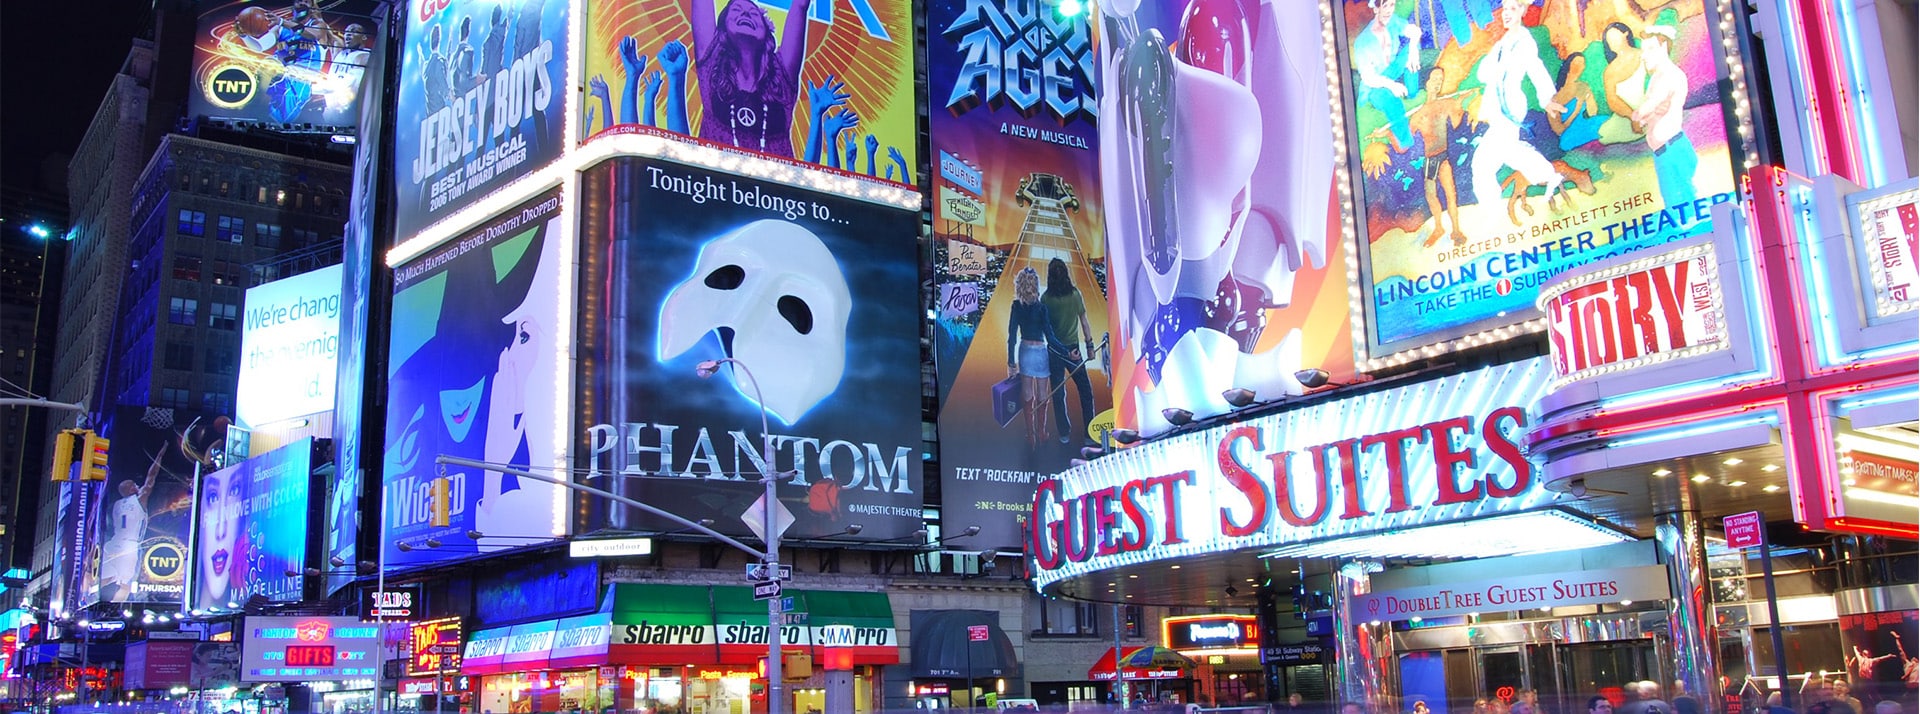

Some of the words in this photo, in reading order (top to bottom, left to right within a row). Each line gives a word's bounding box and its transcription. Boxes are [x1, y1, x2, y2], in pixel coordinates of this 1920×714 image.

[1025, 26, 1053, 51] OF
[216, 80, 250, 94] TNT
[412, 79, 491, 185] JERSEY
[493, 40, 553, 140] BOYS
[1000, 122, 1008, 134] A
[1011, 124, 1038, 140] NEW
[1041, 130, 1089, 150] MUSICAL
[430, 168, 464, 198] BEST
[466, 134, 527, 174] MUSICAL
[942, 158, 980, 188] JOURNEY
[429, 191, 448, 212] 2006
[448, 179, 467, 203] TONY
[466, 166, 496, 193] AWARD
[494, 148, 527, 176] WINNER
[647, 166, 727, 204] Tonight
[732, 181, 806, 221] belongs
[1438, 236, 1501, 262] DIRECTED
[1507, 230, 1527, 244] BY
[1531, 204, 1608, 238] BARTLETT
[1613, 192, 1654, 214] SHER
[405, 264, 424, 282] MUCH
[424, 248, 459, 272] HAPPENED
[459, 233, 484, 256] BEFORE
[486, 214, 522, 242] DOROTHY
[522, 200, 558, 224] DROPPED
[960, 244, 974, 259] Pat
[1880, 236, 1902, 269] STORY
[951, 258, 986, 274] Benatar
[1378, 262, 1478, 306] LINCOLN
[1486, 230, 1596, 278] CENTER
[1414, 297, 1457, 316] TAKE
[1460, 285, 1492, 300] THE
[1690, 281, 1712, 312] WEST
[246, 304, 287, 331] We're
[290, 294, 339, 318] chang
[1548, 260, 1690, 376] STORY
[587, 422, 914, 495] PHANTOM
[956, 467, 981, 480] TEXT
[984, 468, 1034, 484] "ROCKFAN"
[1036, 472, 1047, 484] to
[1032, 470, 1197, 570] GUEST
[1217, 406, 1536, 538] SUITES
[252, 492, 272, 514] WITH
[856, 504, 890, 515] MAJESTIC
[891, 506, 922, 518] THEATRE
[996, 501, 1024, 512] Brooks
[1726, 518, 1733, 526] NO
[1730, 524, 1755, 535] ANYTIME
[150, 556, 178, 568] TNT
[372, 592, 412, 608] TADS
[758, 586, 768, 594] ONE
[1487, 584, 1548, 605] GUEST
[1552, 579, 1618, 600] SUITES
[512, 632, 548, 652] sbarro
[560, 627, 601, 648] sbarro
[624, 620, 704, 644] sbarro
[288, 647, 332, 665] GIFTS
[470, 638, 502, 658] sbarro
[626, 670, 648, 680] Pizza
[700, 670, 722, 679] Pasta
